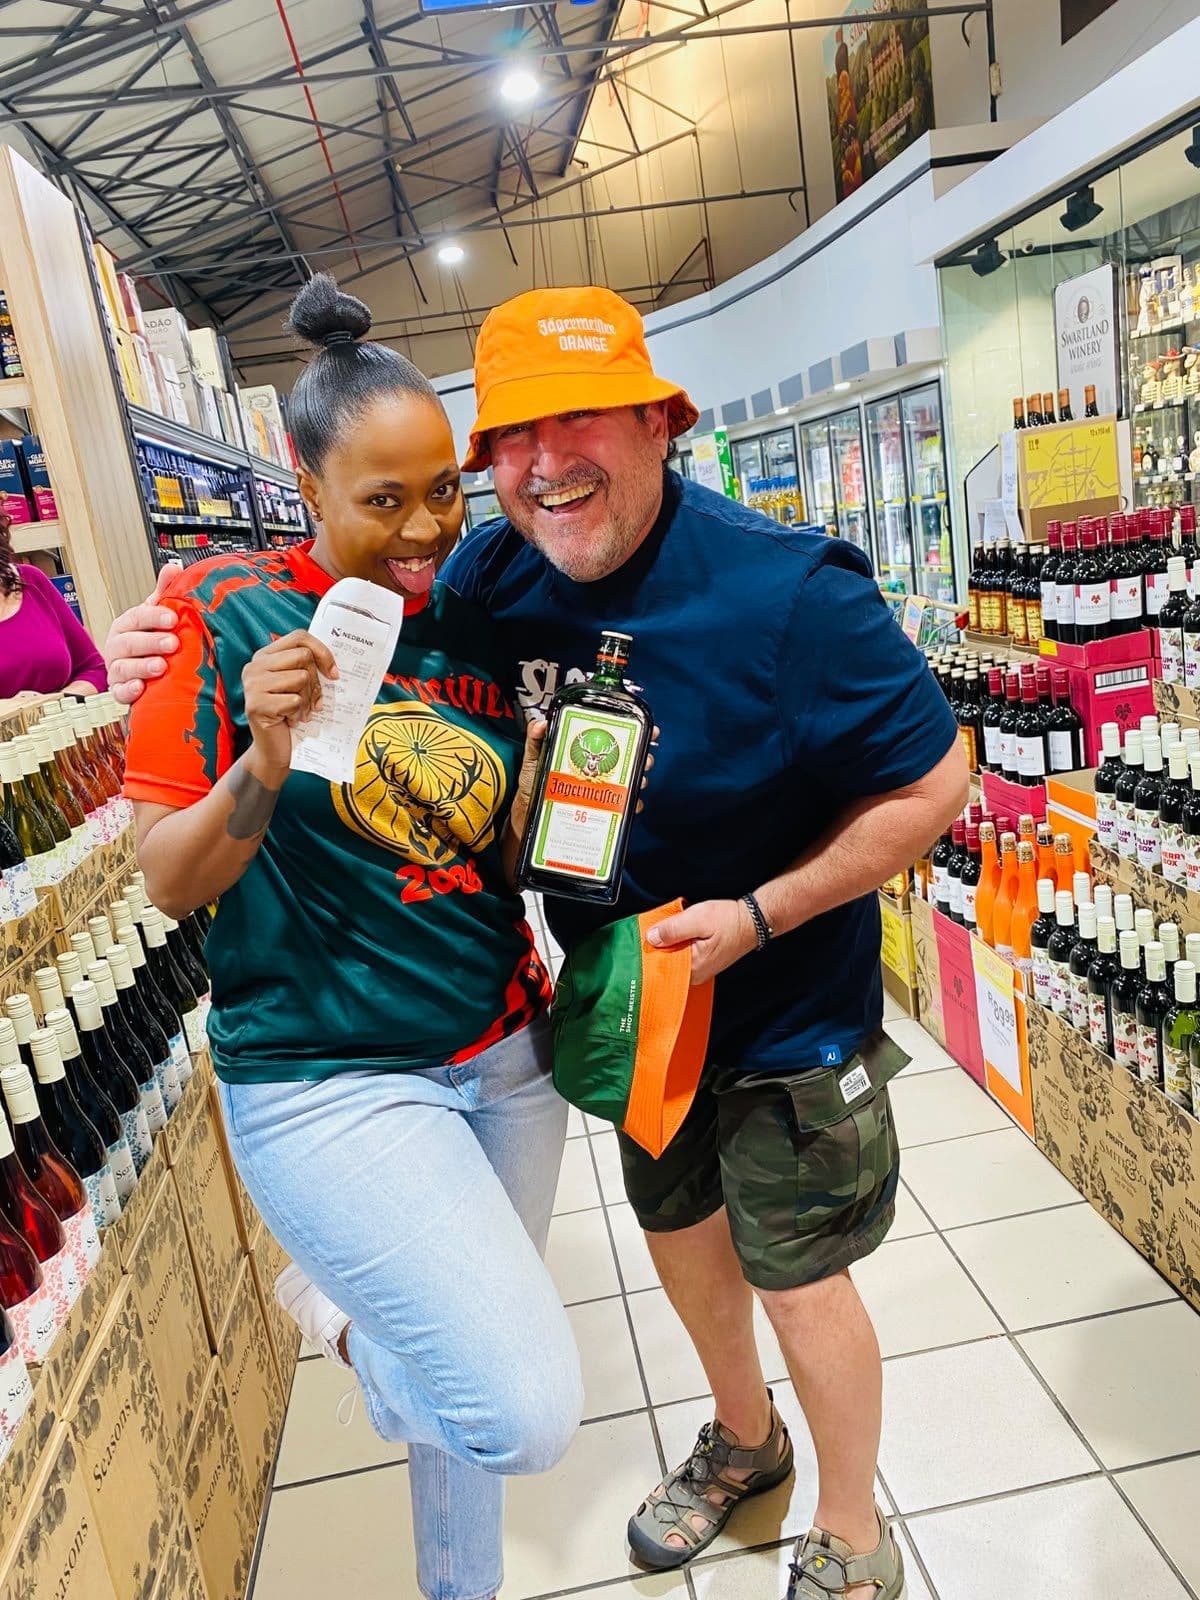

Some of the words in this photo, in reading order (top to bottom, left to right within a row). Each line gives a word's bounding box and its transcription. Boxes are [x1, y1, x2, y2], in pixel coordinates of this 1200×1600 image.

[559, 334, 608, 352] ORANGE
[1061, 319, 1109, 348] SWARTLAND
[1069, 340, 1101, 360] WINERY
[342, 631, 374, 647] NEDBANK
[574, 810, 588, 823] 56
[628, 979, 637, 1012] MEISTER
[92, 1398, 133, 1493] Seasons
[194, 1464, 221, 1543] Seasons
[53, 1516, 89, 1600] asons
